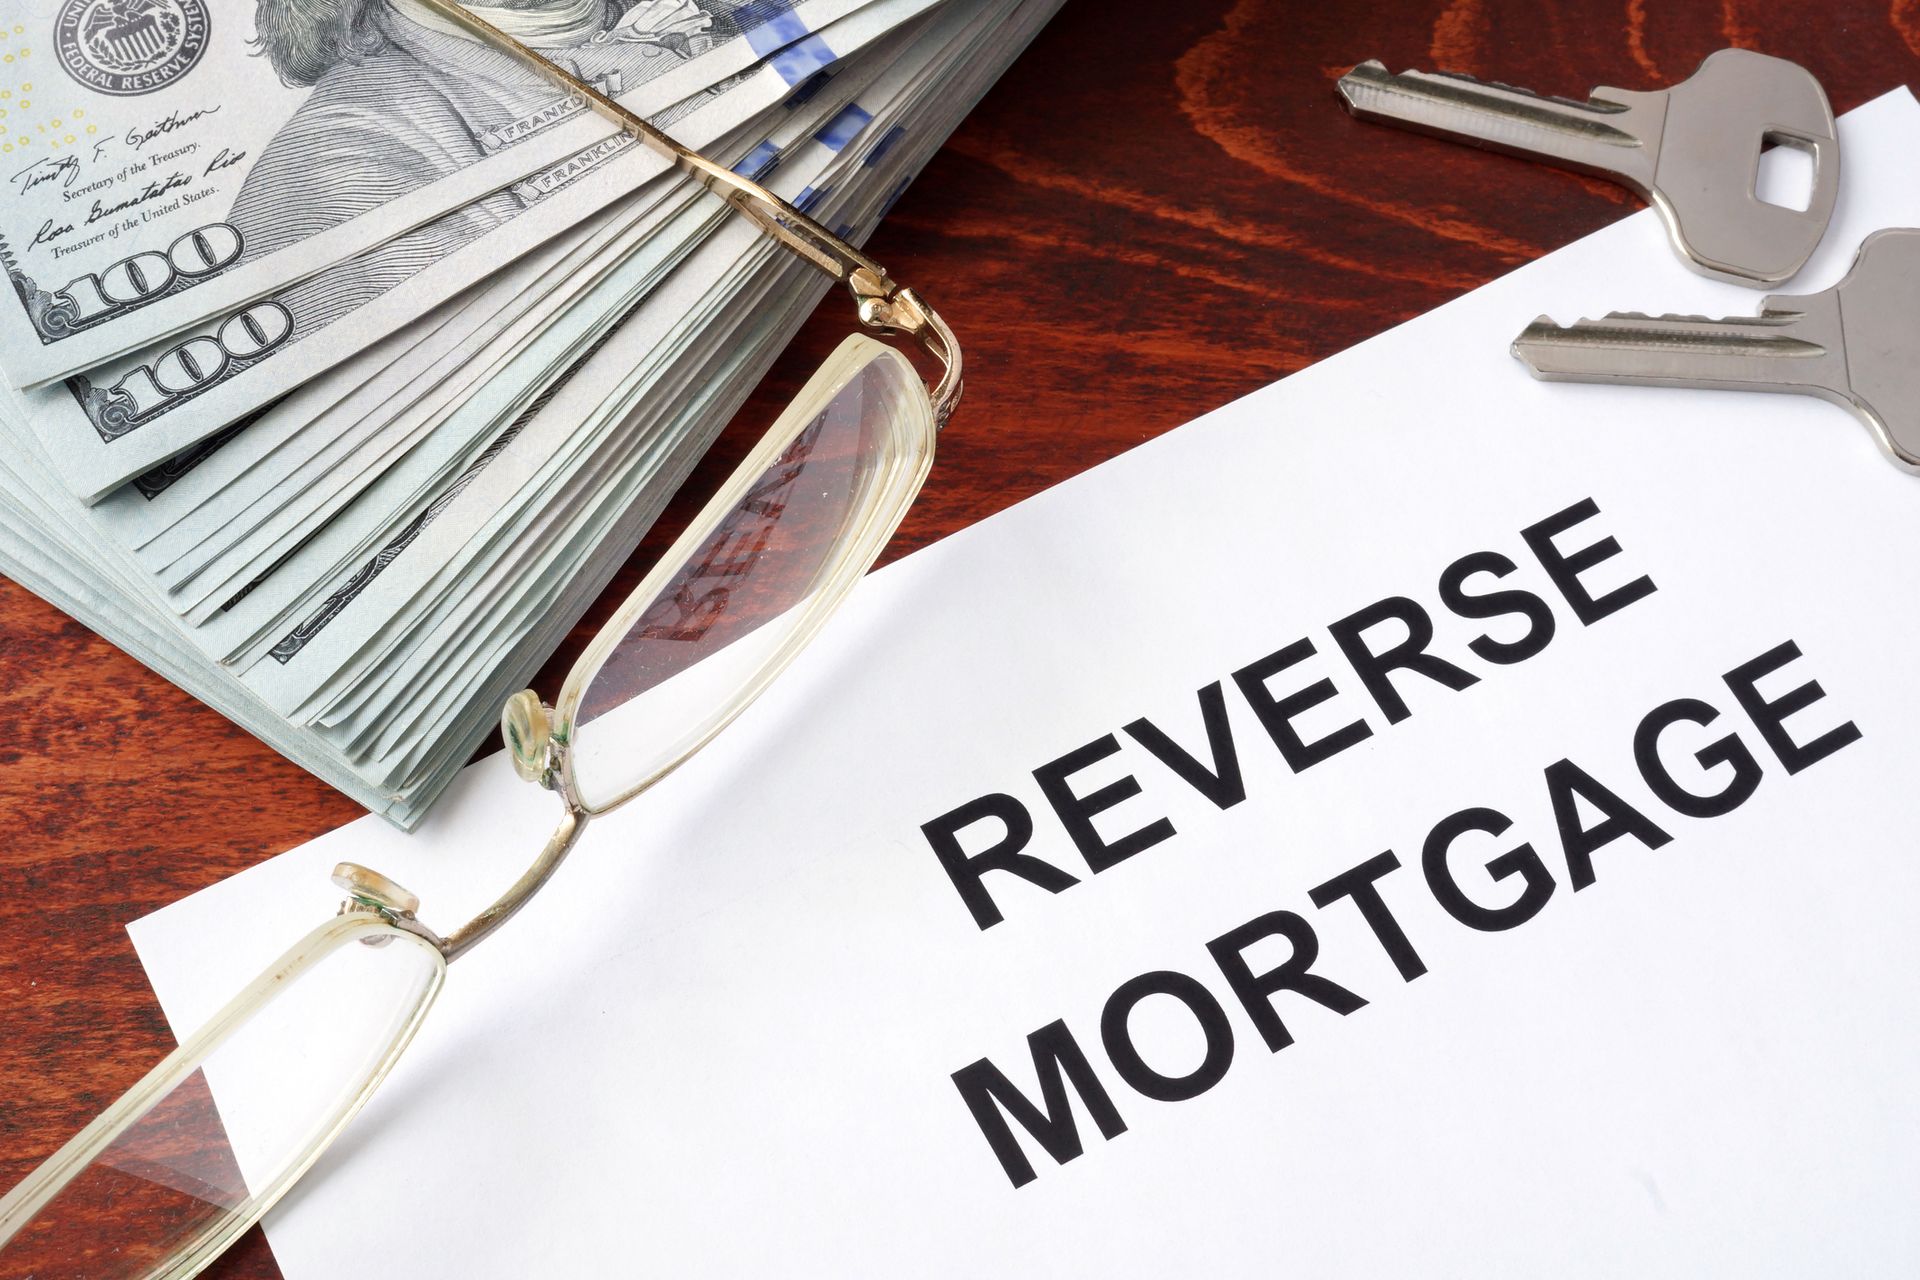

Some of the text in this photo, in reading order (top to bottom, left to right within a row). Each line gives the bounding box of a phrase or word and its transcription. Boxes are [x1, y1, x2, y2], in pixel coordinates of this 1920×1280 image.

[63, 0, 90, 27] UNI
[63, 42, 113, 88] FEDERAL
[121, 53, 191, 89] RESERVE
[504, 96, 584, 138] FRANKL
[62, 141, 201, 202] Secretary of the Treasury.
[541, 129, 634, 188] FRANKLIN
[51, 186, 220, 259] Treasurer of the United States.
[53, 222, 246, 330] 100
[109, 300, 296, 424] 100
[920, 496, 1658, 932] REVERSE
[951, 639, 1863, 1190] MORTGAGE
